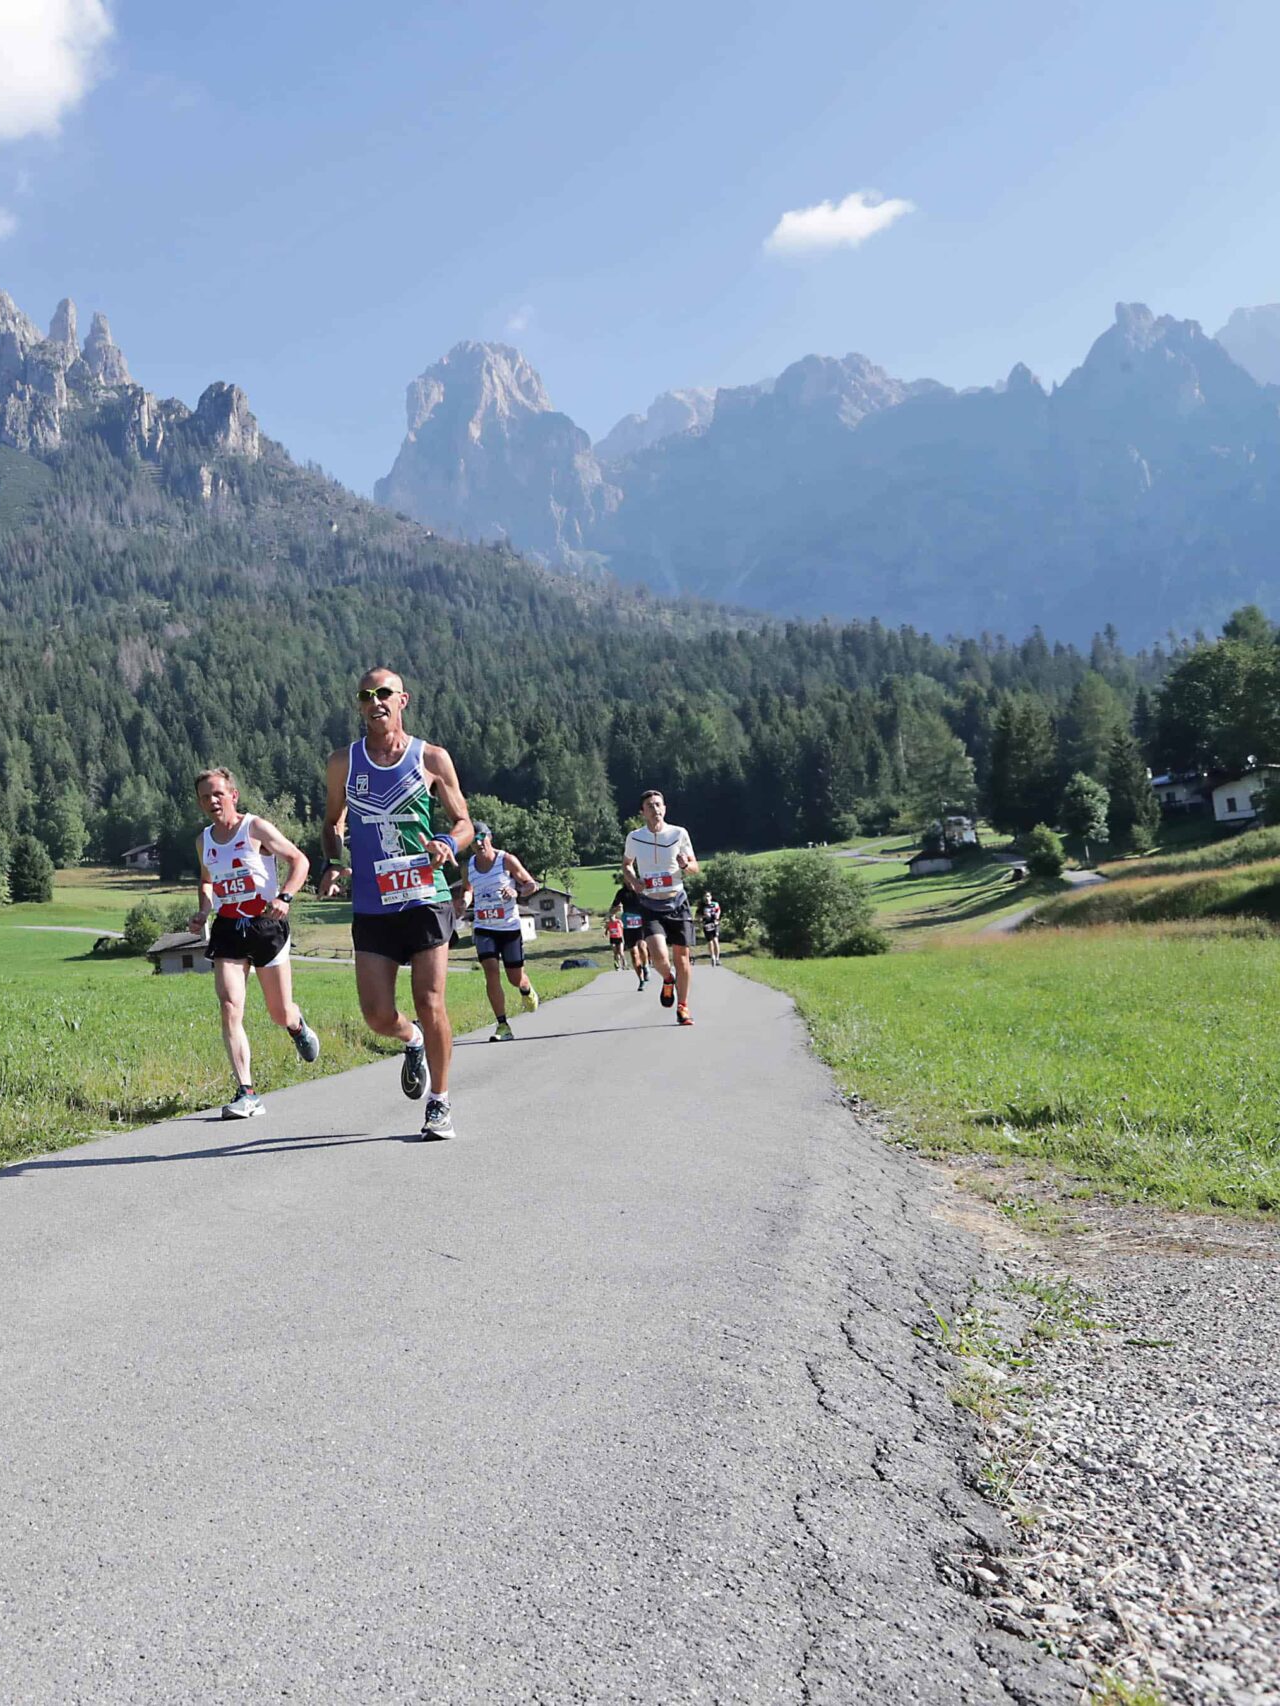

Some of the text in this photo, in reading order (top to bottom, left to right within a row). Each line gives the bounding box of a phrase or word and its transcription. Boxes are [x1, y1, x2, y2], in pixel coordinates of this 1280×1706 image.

[389, 869, 421, 890] 176
[652, 877, 664, 887] 65
[222, 878, 246, 895] 145
[484, 909, 499, 919] 154
